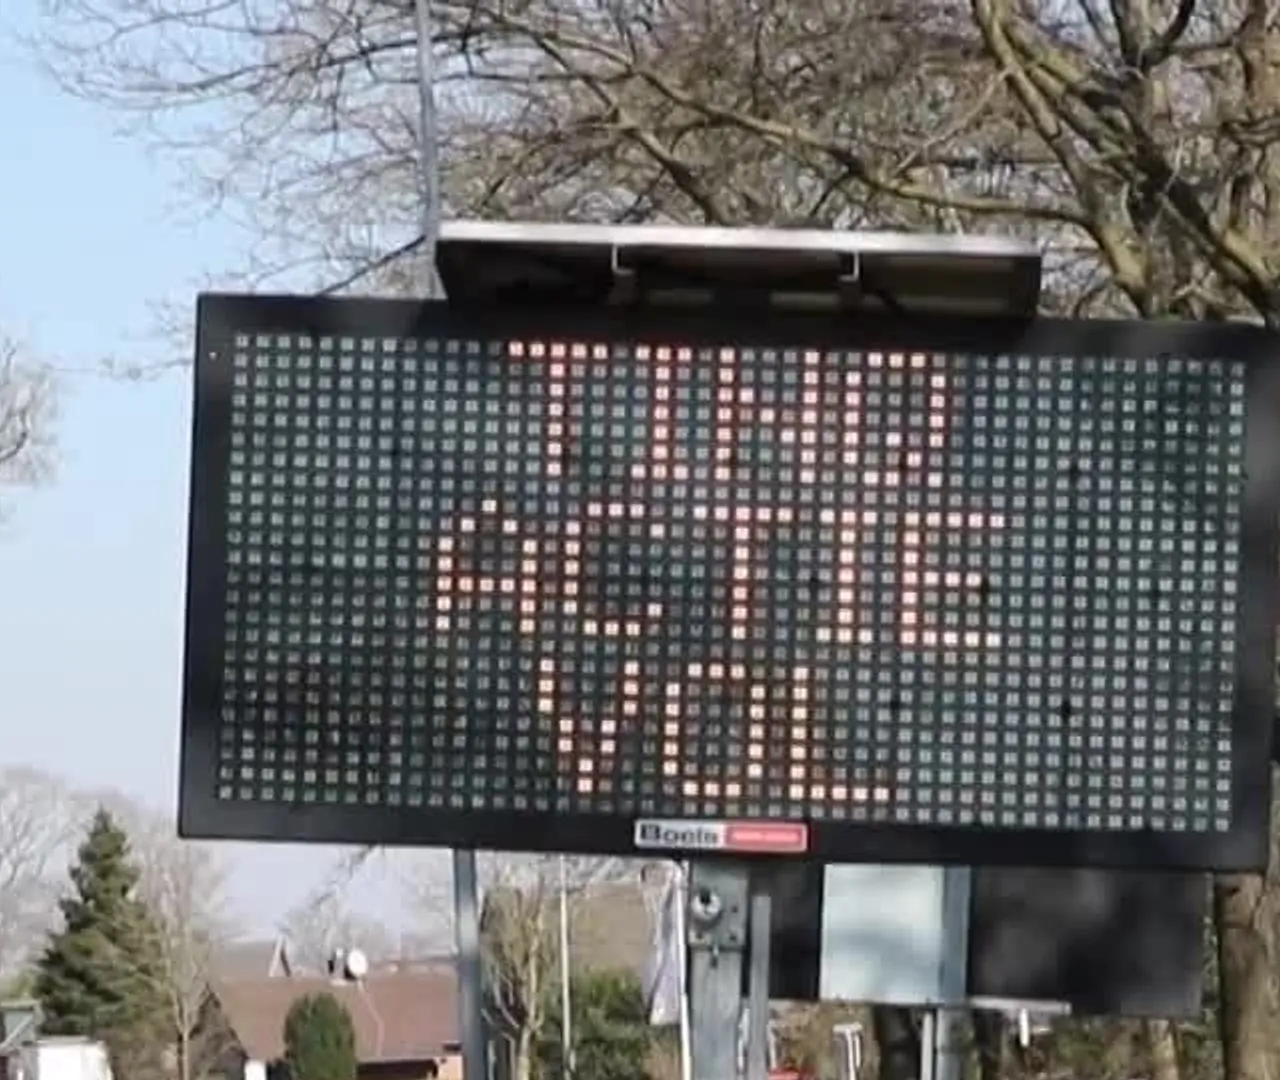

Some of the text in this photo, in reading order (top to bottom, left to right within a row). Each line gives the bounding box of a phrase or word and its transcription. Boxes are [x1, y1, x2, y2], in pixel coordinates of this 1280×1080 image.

[507, 340, 945, 486] TINQ
[436, 498, 1006, 648] ACTIE
[538, 657, 891, 802] VOL
